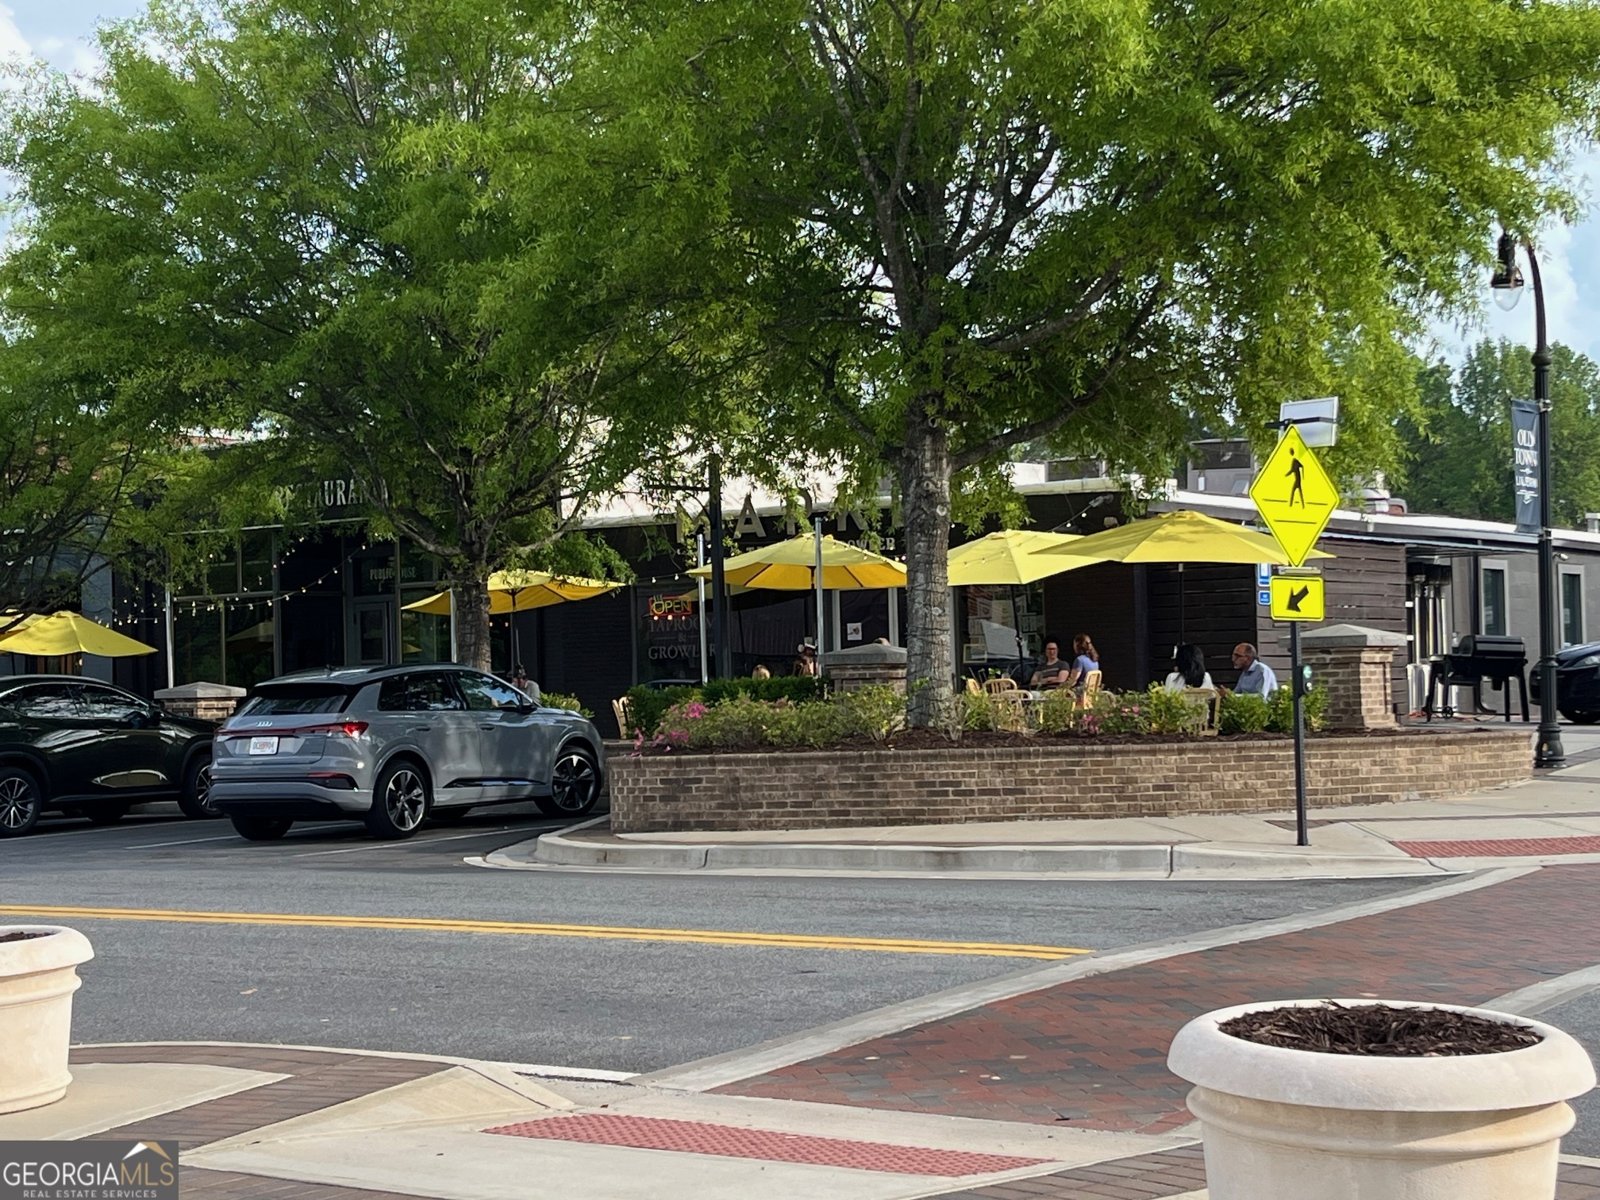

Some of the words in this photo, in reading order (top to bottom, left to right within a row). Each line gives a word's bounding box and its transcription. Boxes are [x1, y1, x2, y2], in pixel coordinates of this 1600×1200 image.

[1516, 429, 1536, 448] OLD
[1514, 448, 1538, 467] TOWN
[652, 599, 690, 614] OPEN
